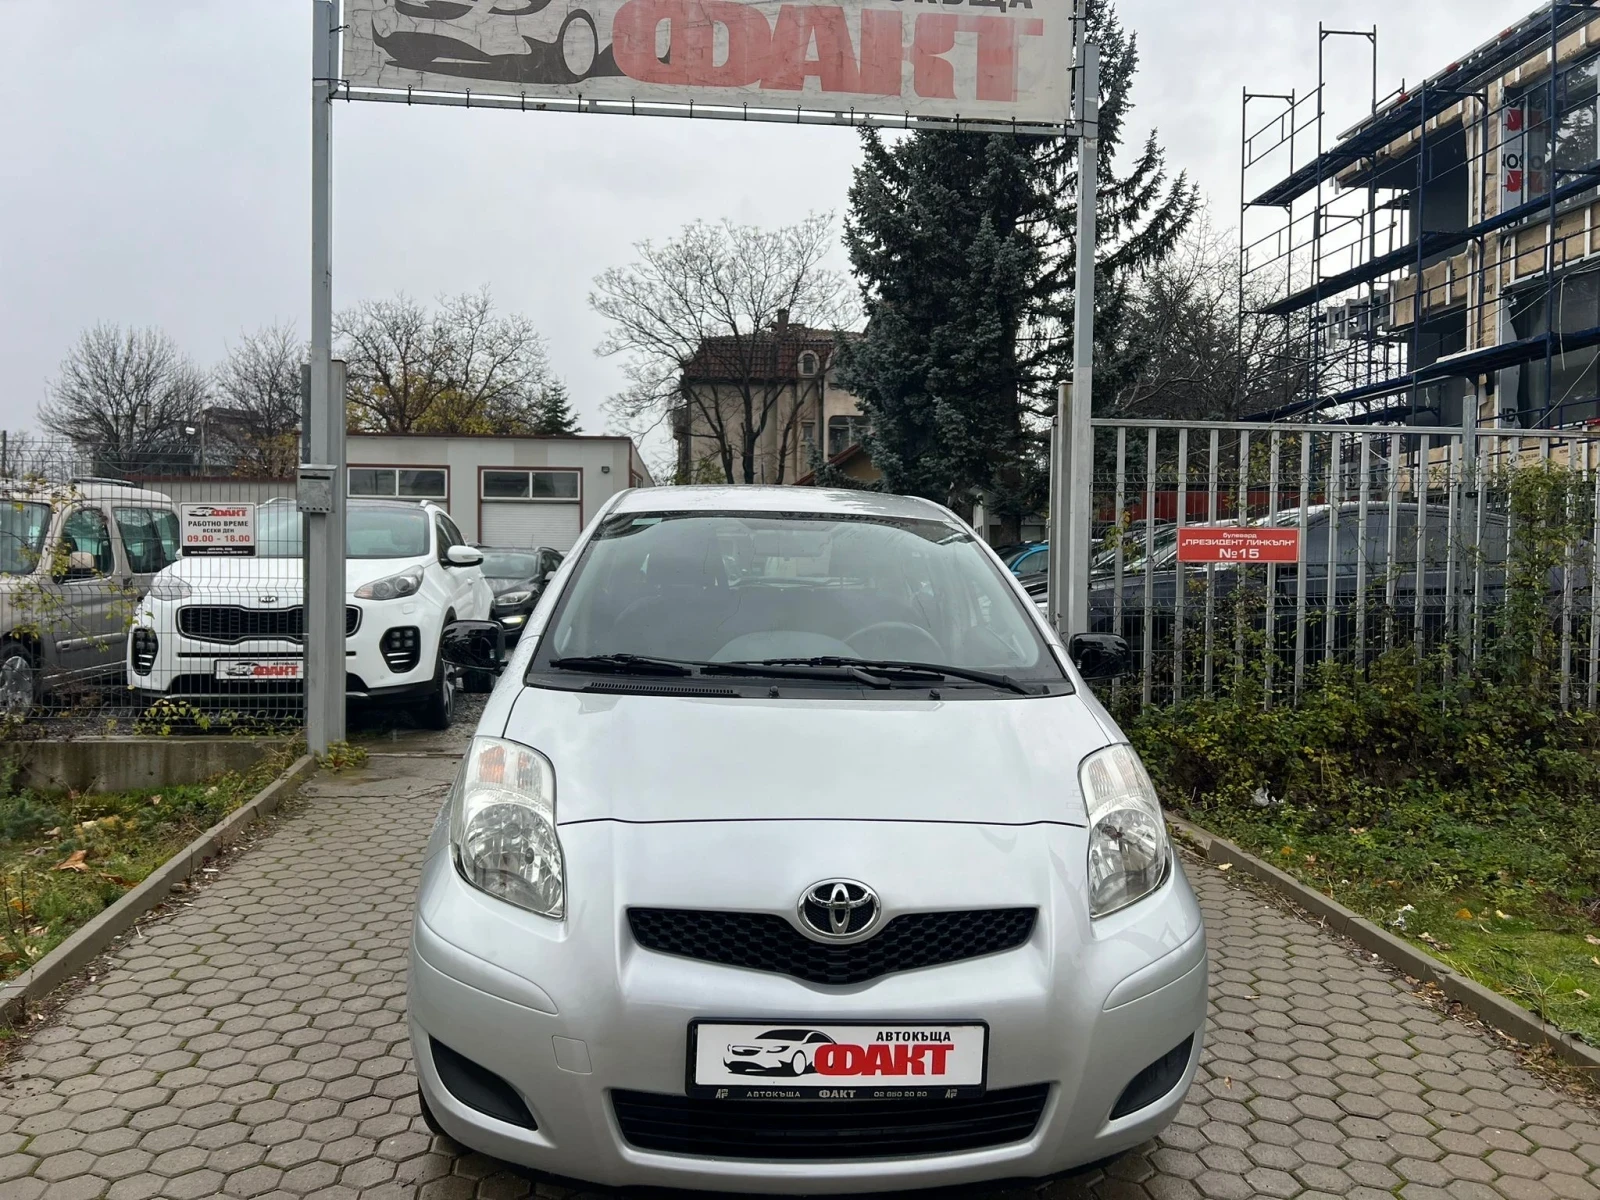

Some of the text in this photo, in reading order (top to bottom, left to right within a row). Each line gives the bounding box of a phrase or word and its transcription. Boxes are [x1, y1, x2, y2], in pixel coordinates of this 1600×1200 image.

[612, 0, 1044, 102] ФАКТ
[187, 535, 214, 543] 09.00
[224, 535, 251, 543] 18.00
[876, 1031, 951, 1042] АВТОКЪЩА
[814, 1043, 955, 1076] ФАКТ
[818, 1089, 857, 1099] ФАКТ
